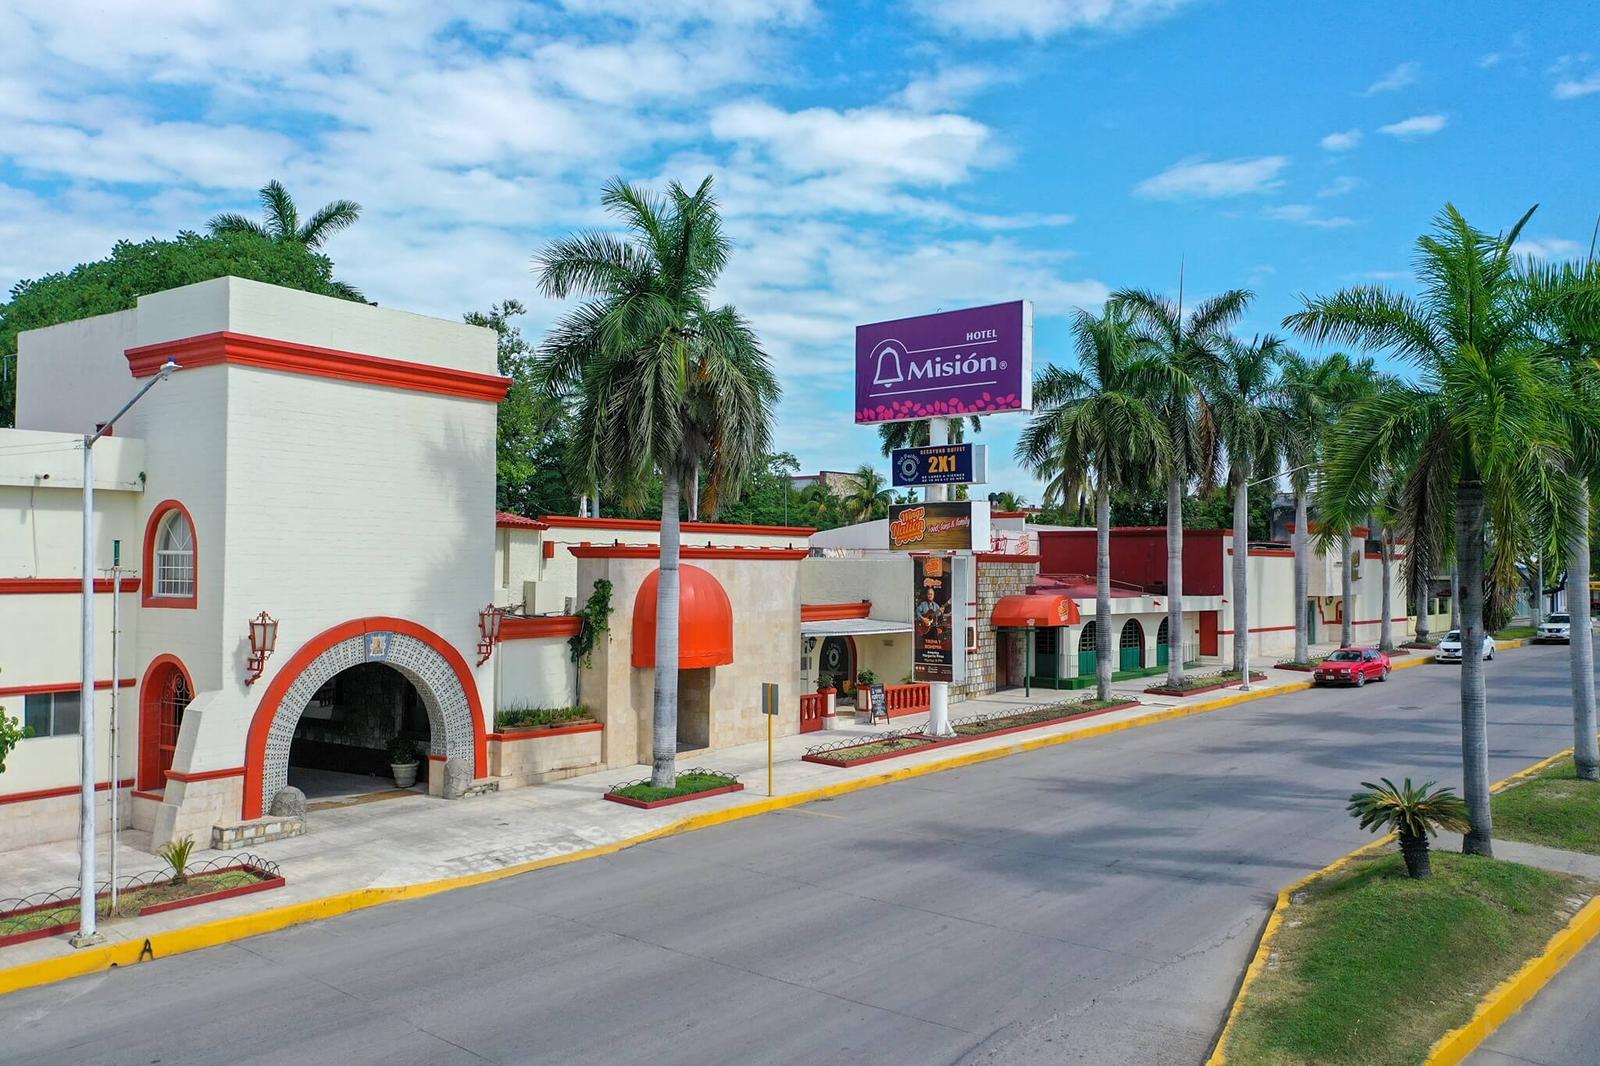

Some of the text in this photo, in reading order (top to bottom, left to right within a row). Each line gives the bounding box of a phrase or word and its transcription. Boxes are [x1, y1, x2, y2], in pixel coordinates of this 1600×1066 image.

[966, 329, 998, 341] HOTEL
[907, 352, 997, 381] Misión
[928, 455, 957, 474] 2X1
[891, 519, 924, 537] Nation
[138, 938, 154, 962] A
